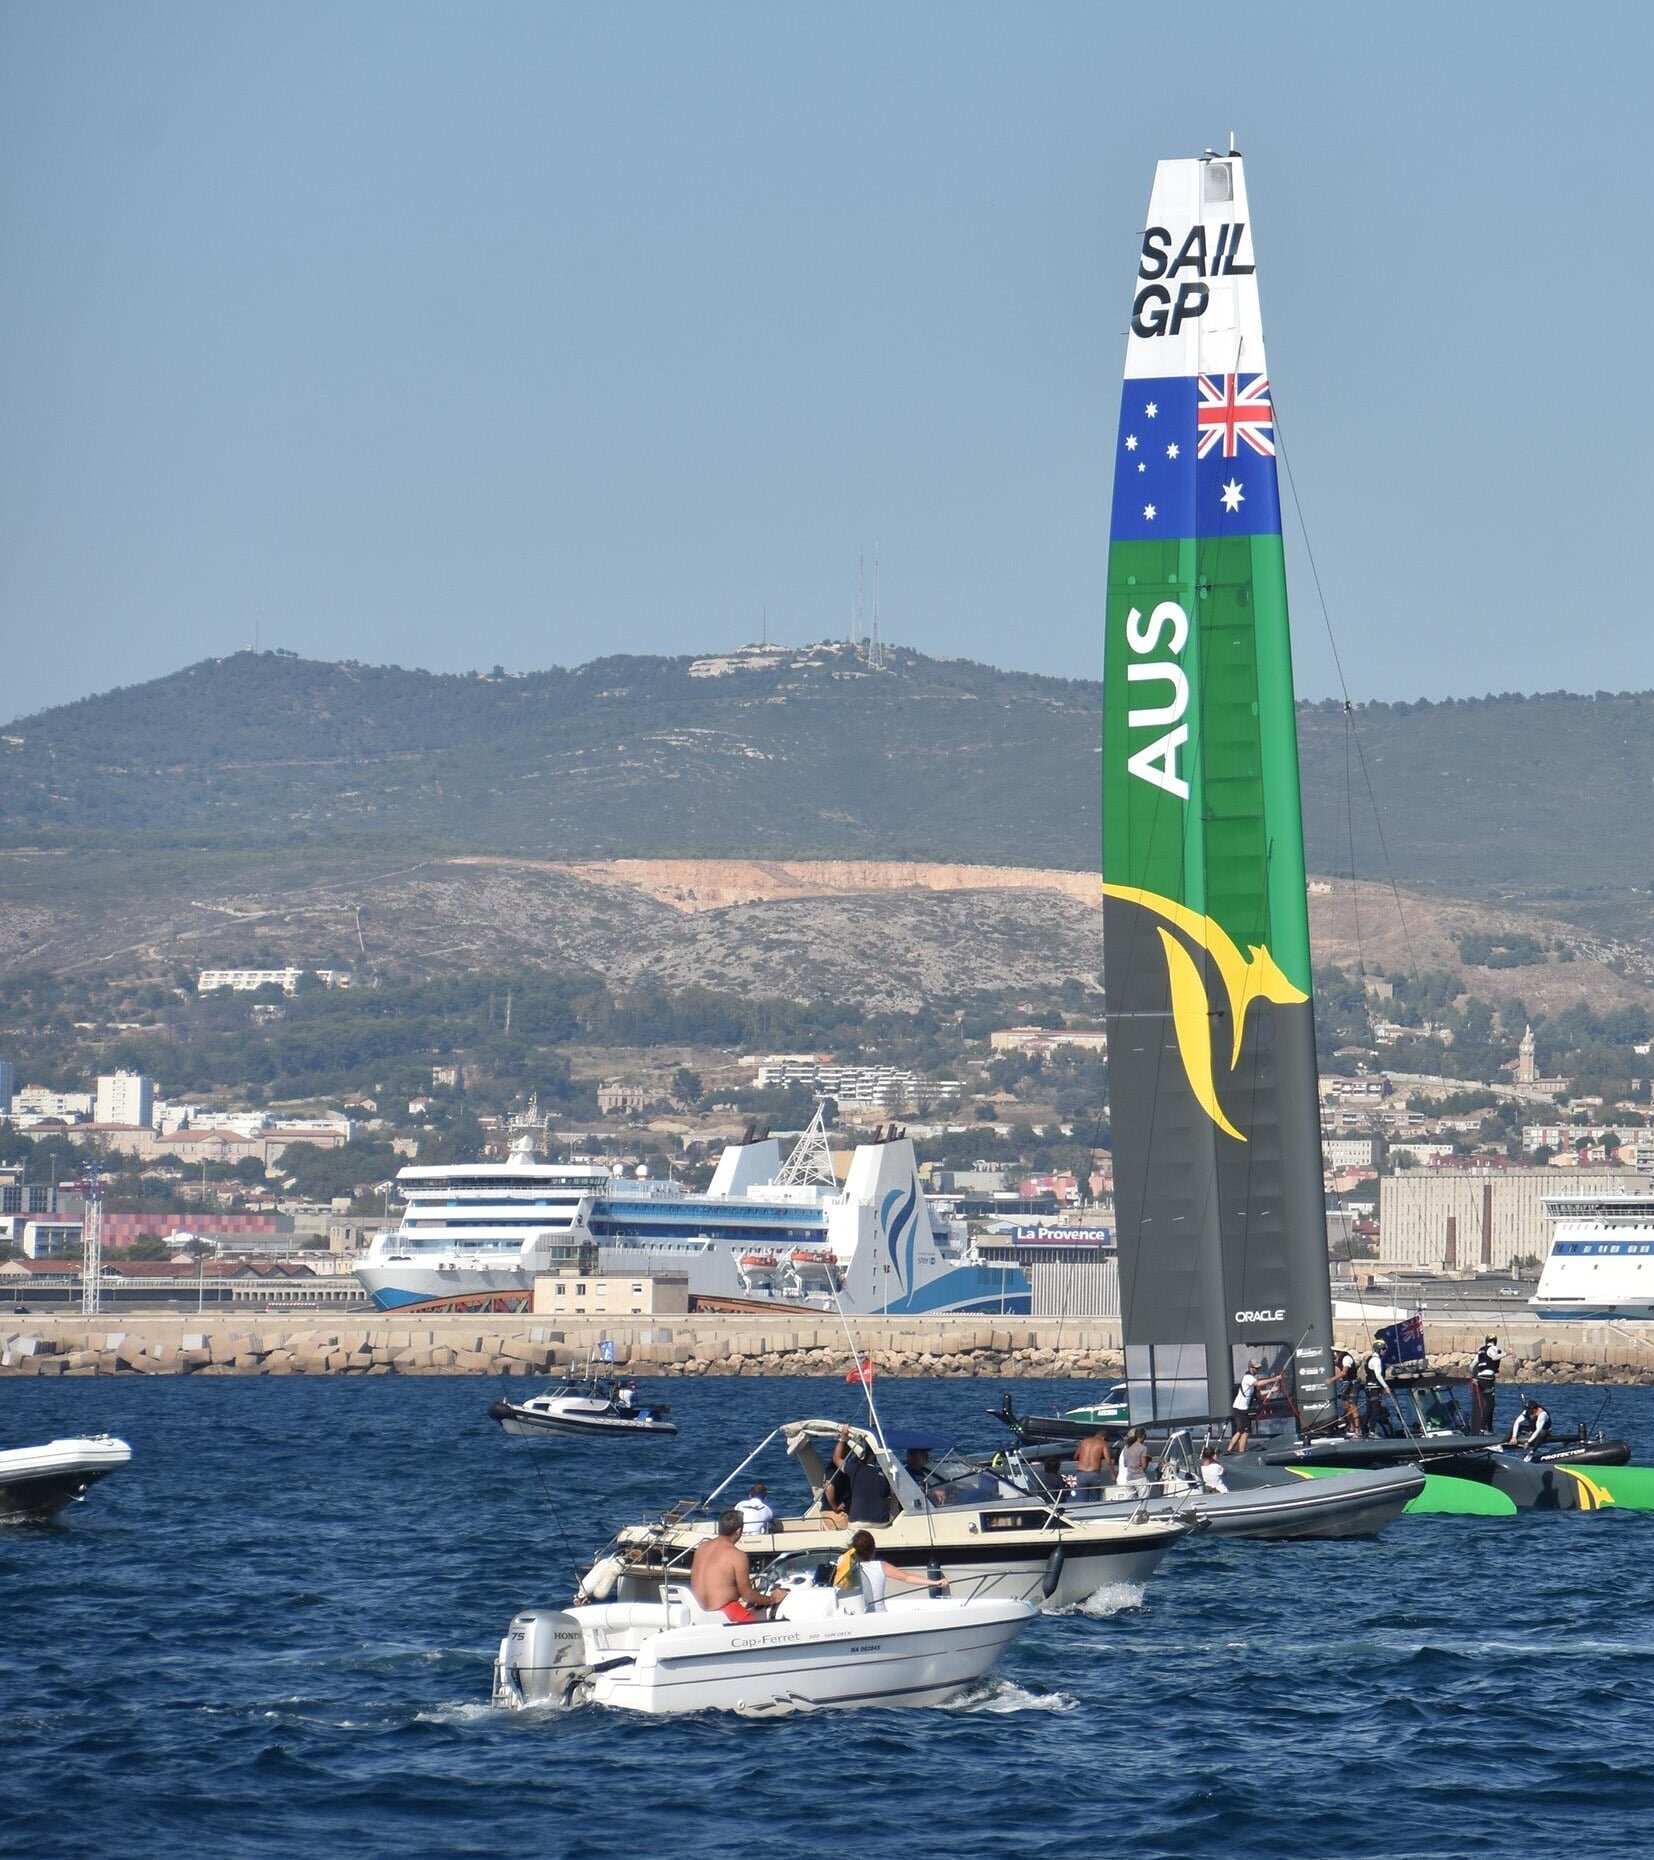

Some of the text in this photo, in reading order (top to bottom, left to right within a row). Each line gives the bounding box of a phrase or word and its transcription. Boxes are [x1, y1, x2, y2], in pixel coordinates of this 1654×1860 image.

[1138, 223, 1256, 280] SAIL
[1130, 282, 1210, 338] GP
[1127, 601, 1189, 800] AUS
[1017, 1228, 1105, 1240] La Provence
[1235, 1310, 1285, 1322] ORACLE
[1541, 1448, 1586, 1461] PROTECTOR
[511, 1632, 525, 1640] 75
